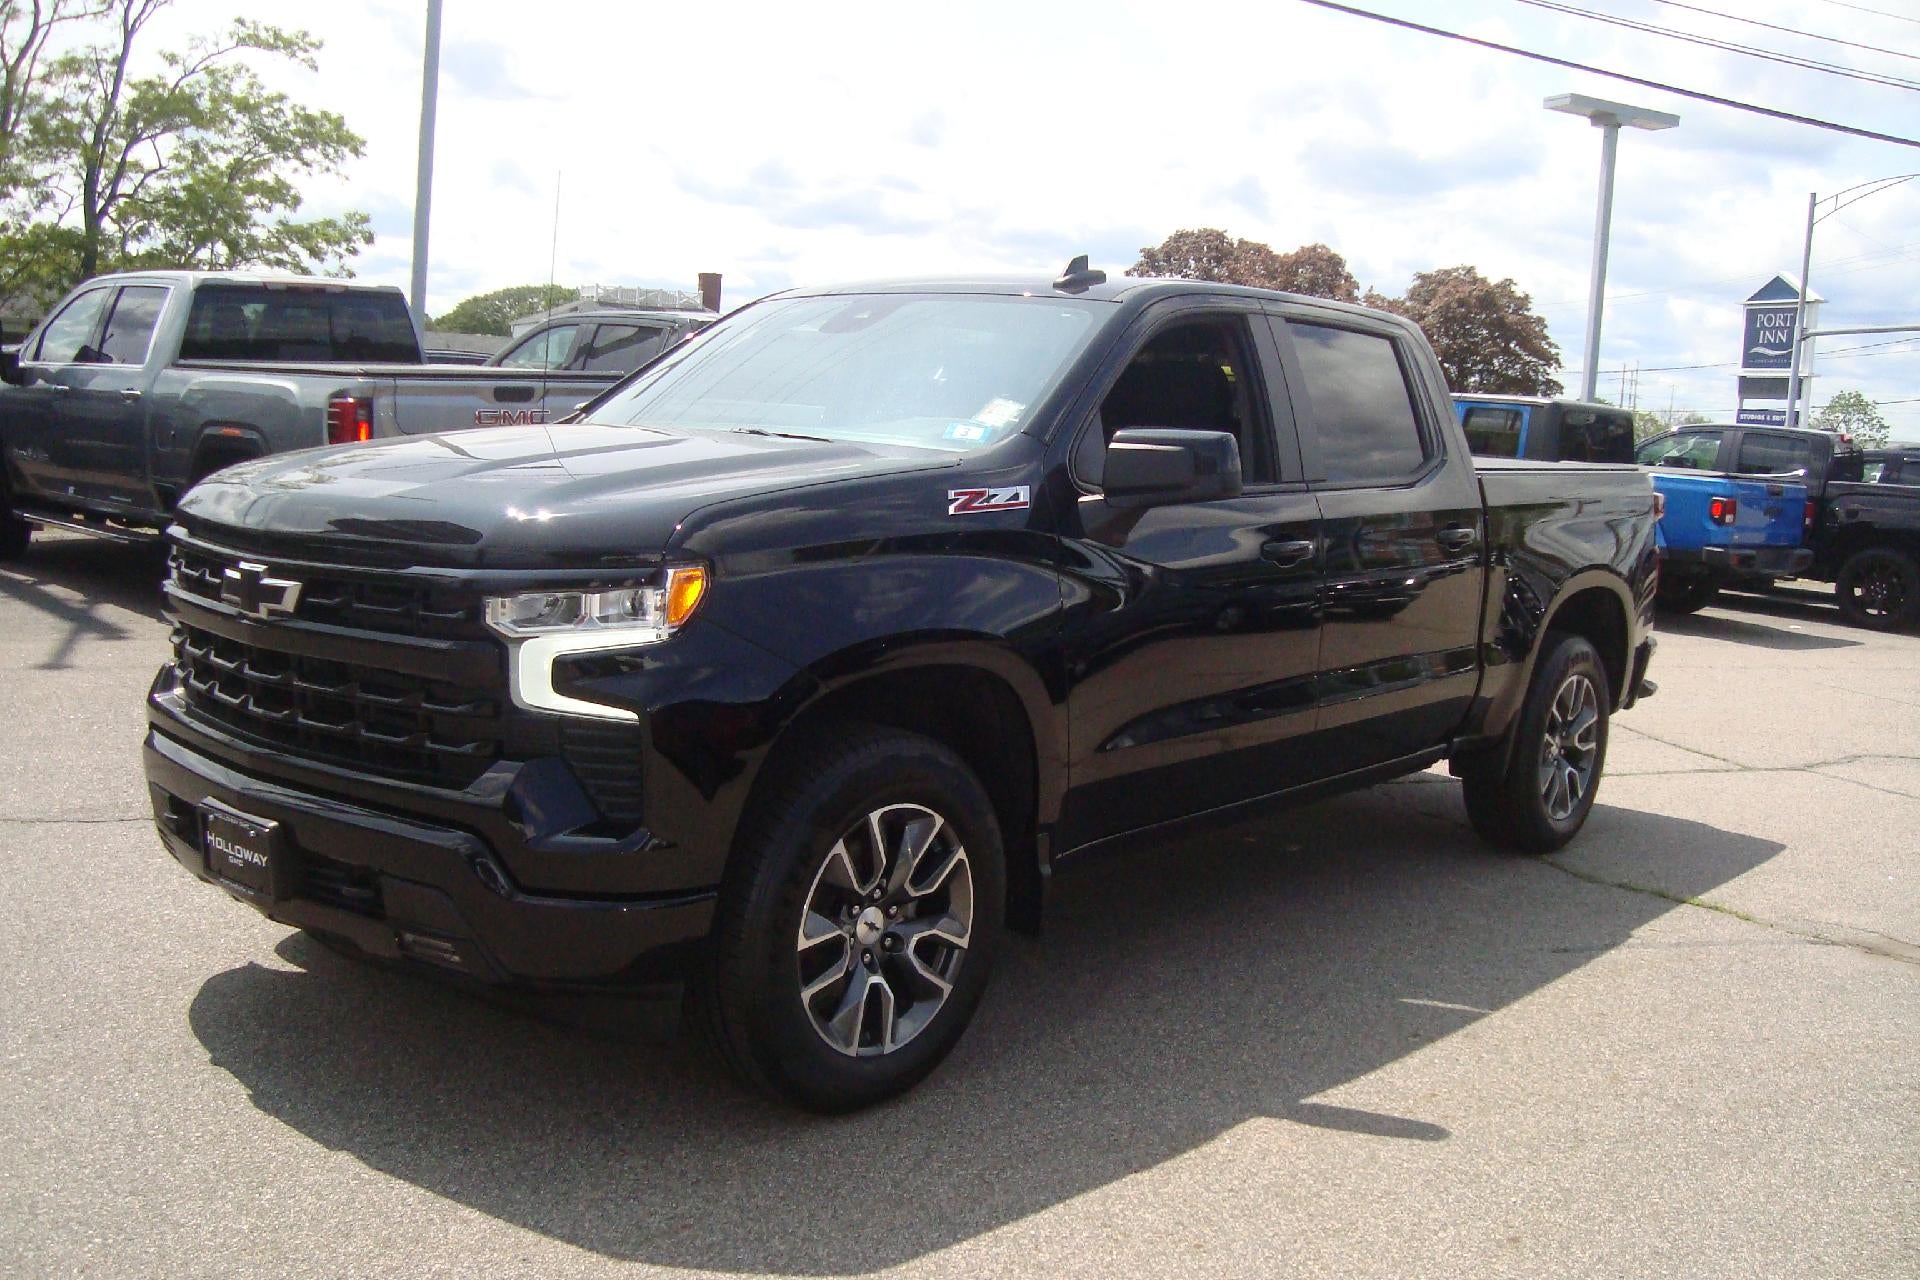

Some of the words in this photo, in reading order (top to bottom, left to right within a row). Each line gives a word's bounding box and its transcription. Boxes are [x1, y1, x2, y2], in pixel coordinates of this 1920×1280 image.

[1757, 313, 1793, 327] PORT
[1759, 330, 1787, 344] INN
[475, 408, 551, 425] GMC
[947, 485, 1030, 515] Z71
[207, 831, 268, 867] HOLLOWAY
